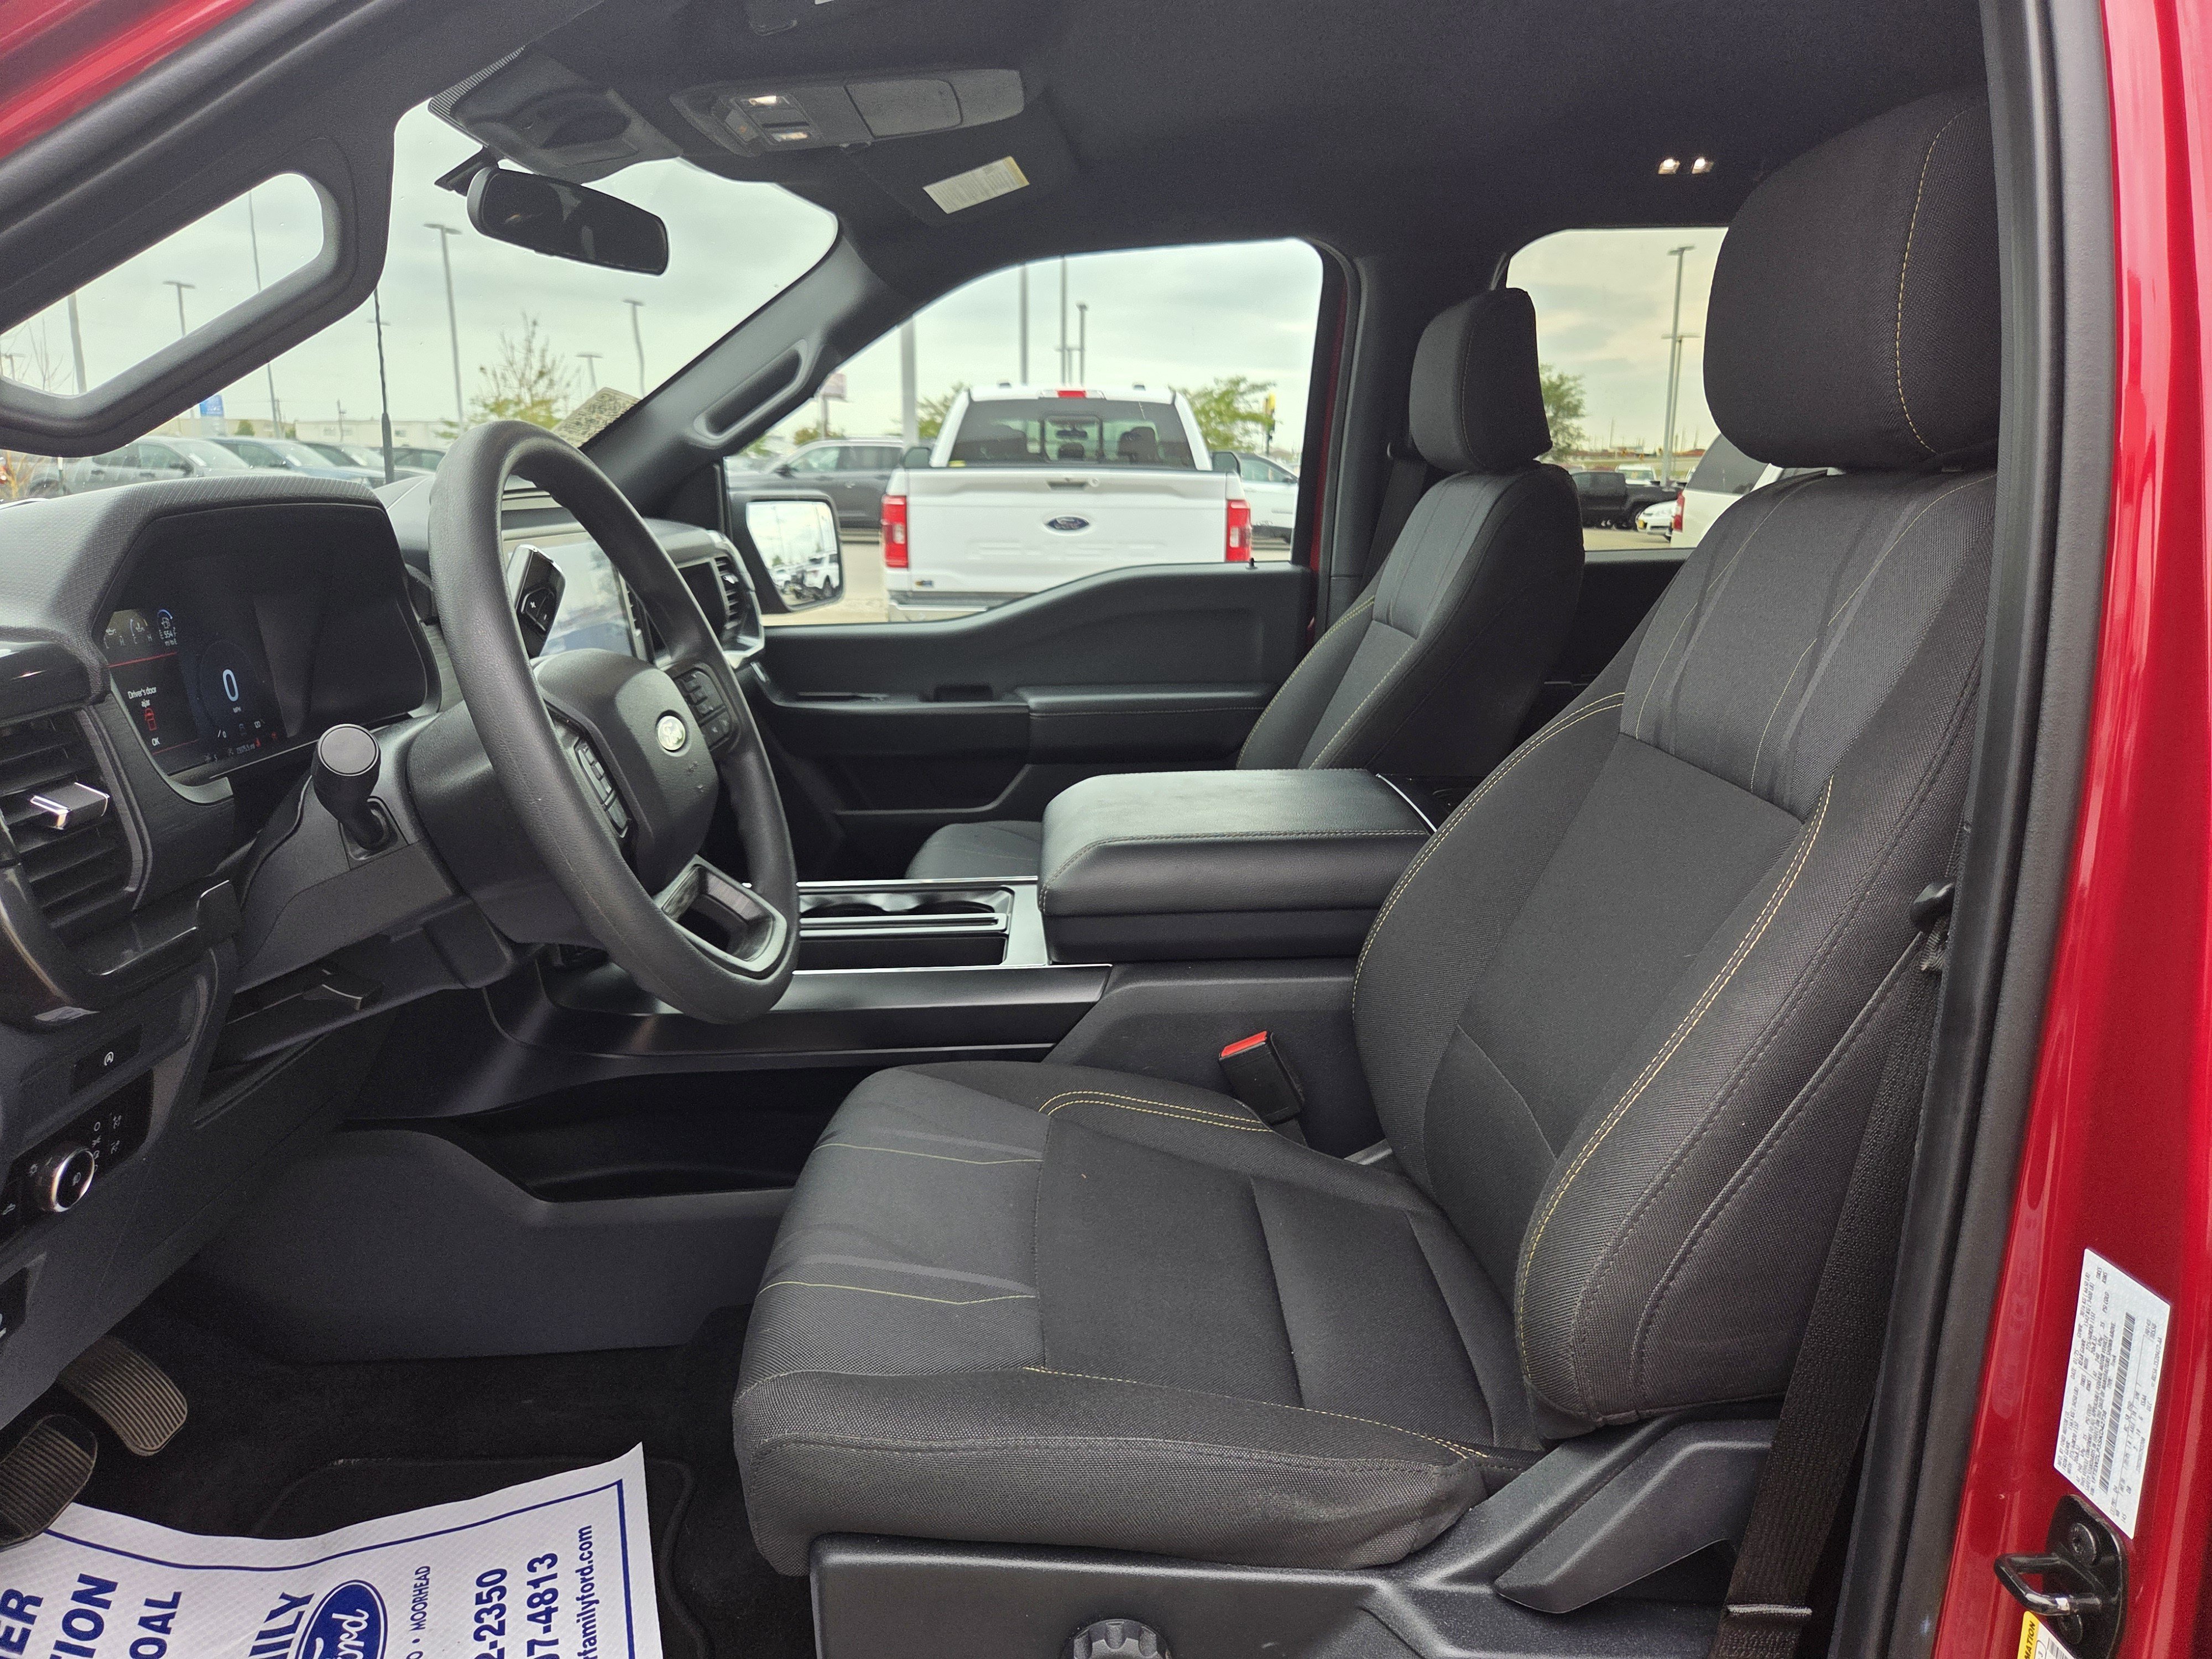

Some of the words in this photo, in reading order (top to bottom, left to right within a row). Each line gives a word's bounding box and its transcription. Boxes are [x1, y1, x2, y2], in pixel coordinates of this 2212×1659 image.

[128, 688, 147, 700] Driver's
[145, 687, 156, 695] door
[223, 669, 239, 701] 0
[152, 737, 160, 746] OK
[0, 1588, 43, 1659] ER
[50, 1573, 118, 1659] ION
[249, 1592, 315, 1659] ILY
[408, 1566, 431, 1631] MOORHEAD
[526, 1552, 560, 1659] 7-4813
